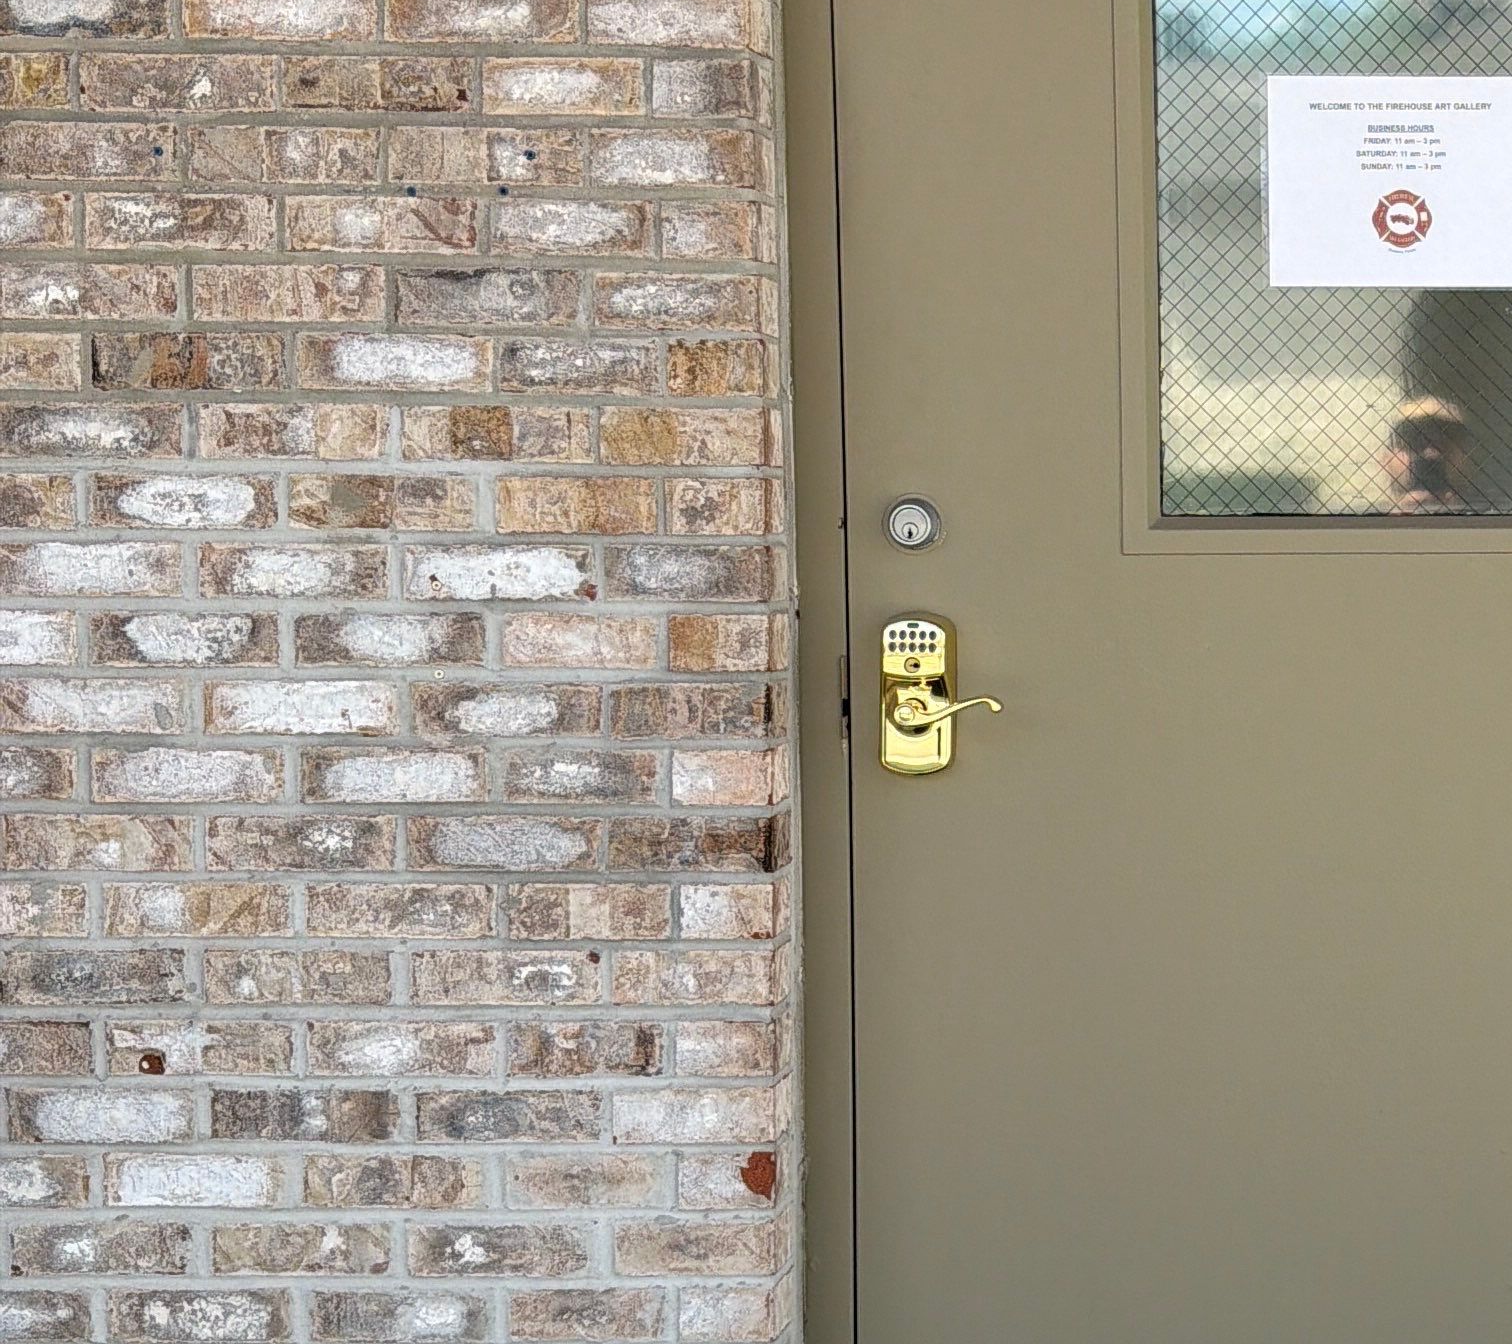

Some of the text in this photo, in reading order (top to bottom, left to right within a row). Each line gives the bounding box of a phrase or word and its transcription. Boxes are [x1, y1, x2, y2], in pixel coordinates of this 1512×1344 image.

[1309, 102, 1492, 111] WELCOME TO THE FIREHOUSE ART GALLERY
[1367, 124, 1435, 133] BUSINESS HOURS
[1363, 137, 1392, 145] FRIDAY:
[1394, 137, 1402, 145] 11
[1429, 138, 1440, 146] pm
[1355, 150, 1398, 158] SATURDAY:
[1400, 150, 1408, 158] 11
[1434, 151, 1446, 159] pm
[1360, 162, 1394, 170] SUNDAY:
[1395, 162, 1403, 170] 11
[1430, 164, 1441, 172] pm
